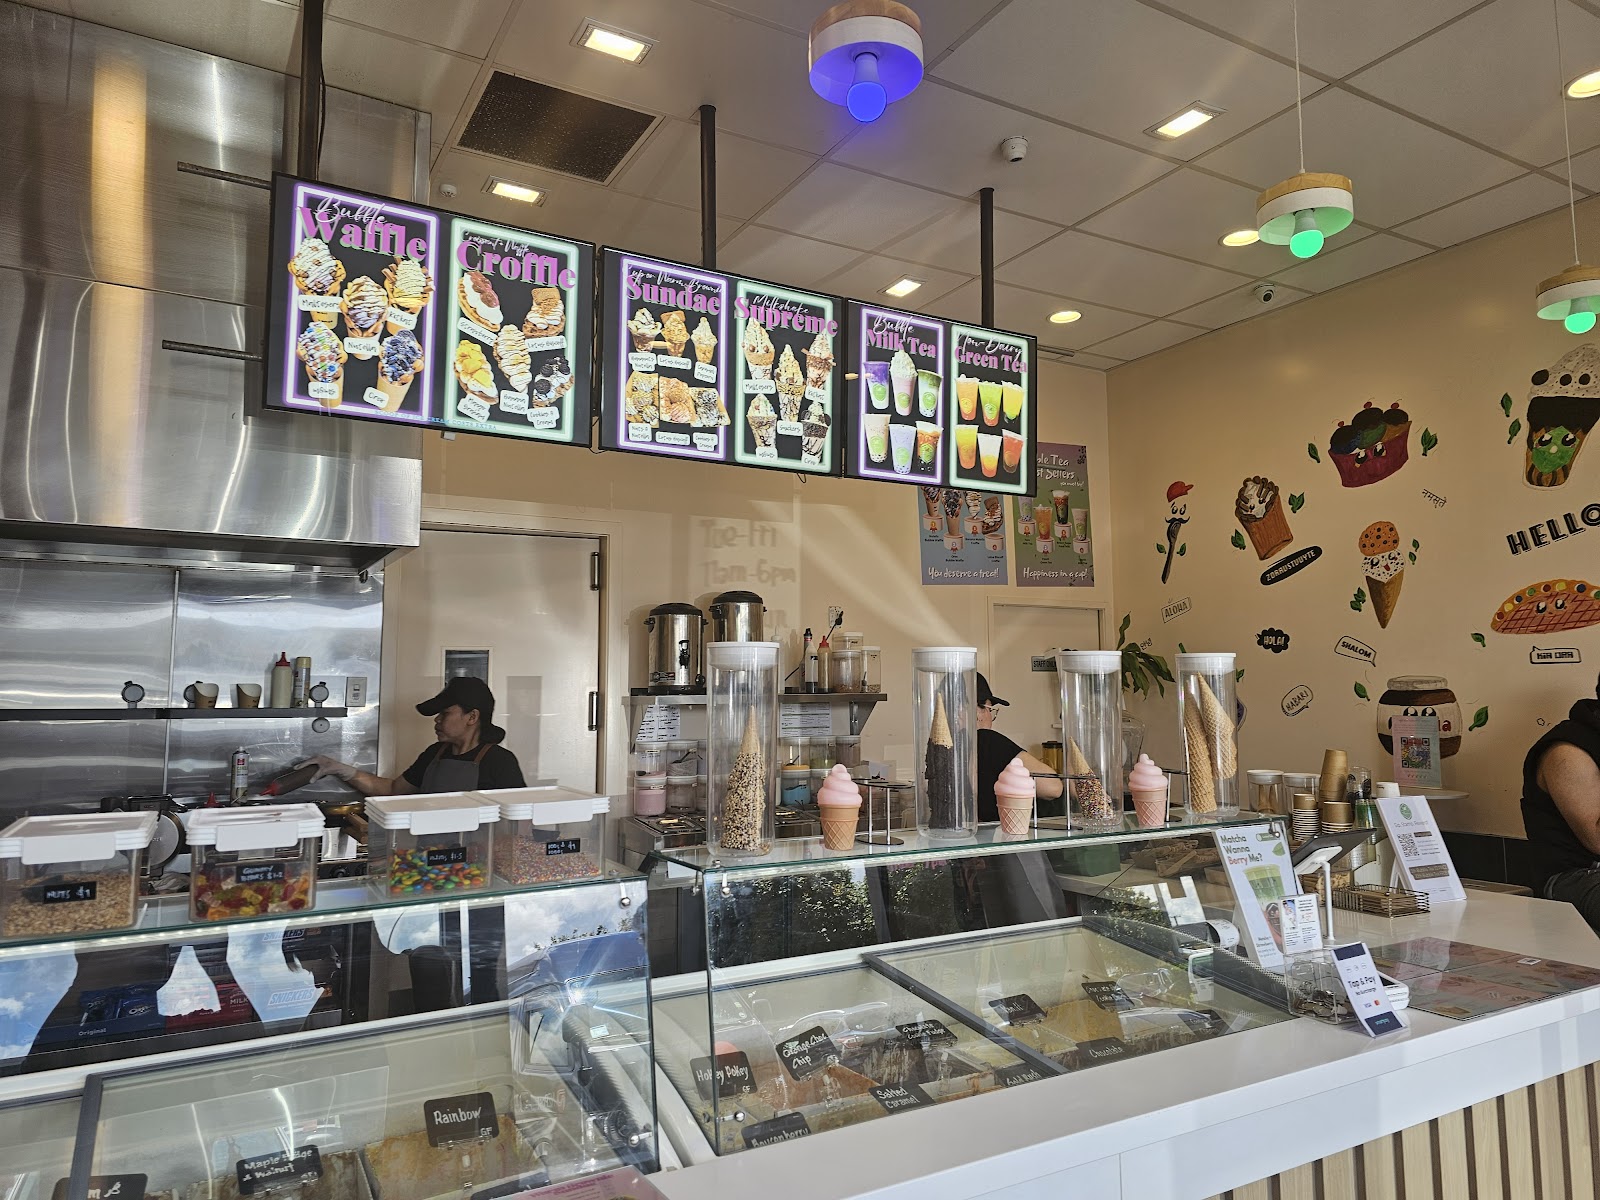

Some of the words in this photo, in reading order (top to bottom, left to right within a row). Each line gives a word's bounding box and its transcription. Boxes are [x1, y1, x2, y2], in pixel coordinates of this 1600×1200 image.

[314, 197, 387, 234] Bubble
[297, 206, 427, 263] Waffle
[457, 241, 577, 291] Croffle
[627, 275, 721, 316] Sundae
[752, 294, 810, 315] Milkshake
[734, 296, 839, 338] Supreme
[873, 314, 914, 341] Bubble
[866, 329, 905, 351] Milk
[906, 338, 936, 358] Tea
[955, 346, 999, 369] Green
[1001, 355, 1027, 373] Tea
[1050, 454, 1070, 466] Tea
[1506, 503, 1600, 556] HELLO
[928, 567, 943, 579] You
[943, 567, 972, 578] deserve
[979, 567, 999, 578] treat!
[1023, 567, 1058, 580] Happiness
[1074, 568, 1088, 580] cup!
[1164, 602, 1188, 620] ALOHA
[1263, 634, 1286, 647] HOLA!
[1341, 640, 1372, 659] SHALOM
[1285, 690, 1309, 712] HABARI
[1220, 835, 1247, 844] Matcha
[1223, 845, 1250, 854] Wanna
[1228, 857, 1248, 866] Berry
[1249, 854, 1263, 862] Me?
[1348, 980, 1360, 989] Tap
[1365, 976, 1376, 985] Pay
[270, 988, 315, 1005] SNICKERS
[79, 1028, 107, 1036] Original
[792, 1055, 812, 1069] Chip
[725, 1064, 749, 1081] Pokey
[878, 1086, 908, 1100] Salted
[885, 1096, 920, 1109] Caramel
[434, 1106, 482, 1126] Rainbow
[244, 1156, 280, 1170] Maple
